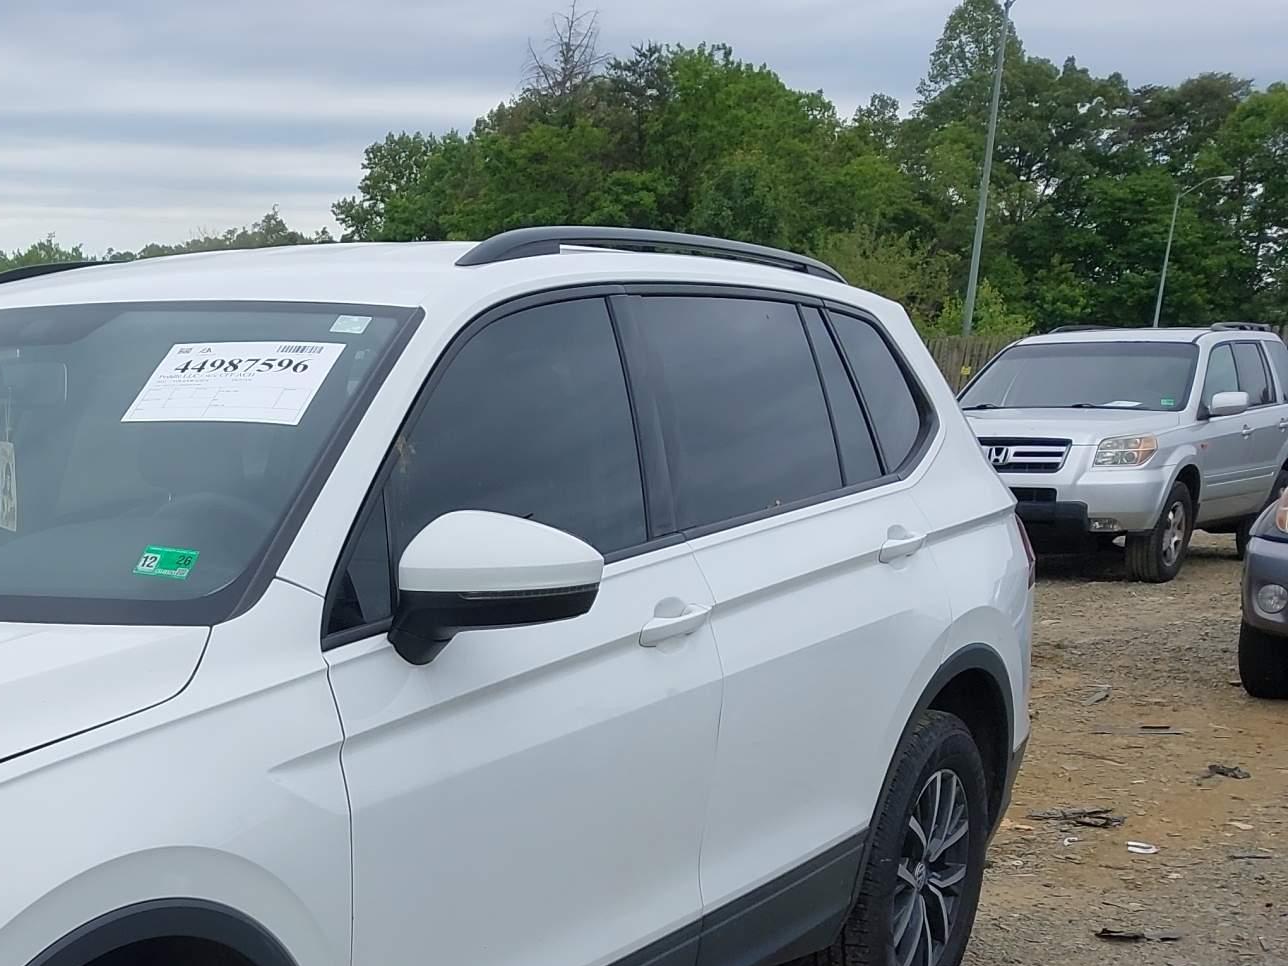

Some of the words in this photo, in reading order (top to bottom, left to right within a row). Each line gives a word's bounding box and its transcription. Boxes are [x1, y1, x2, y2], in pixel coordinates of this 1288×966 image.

[174, 358, 314, 373] 44987596
[141, 555, 158, 568] 12
[176, 555, 193, 567] 26
